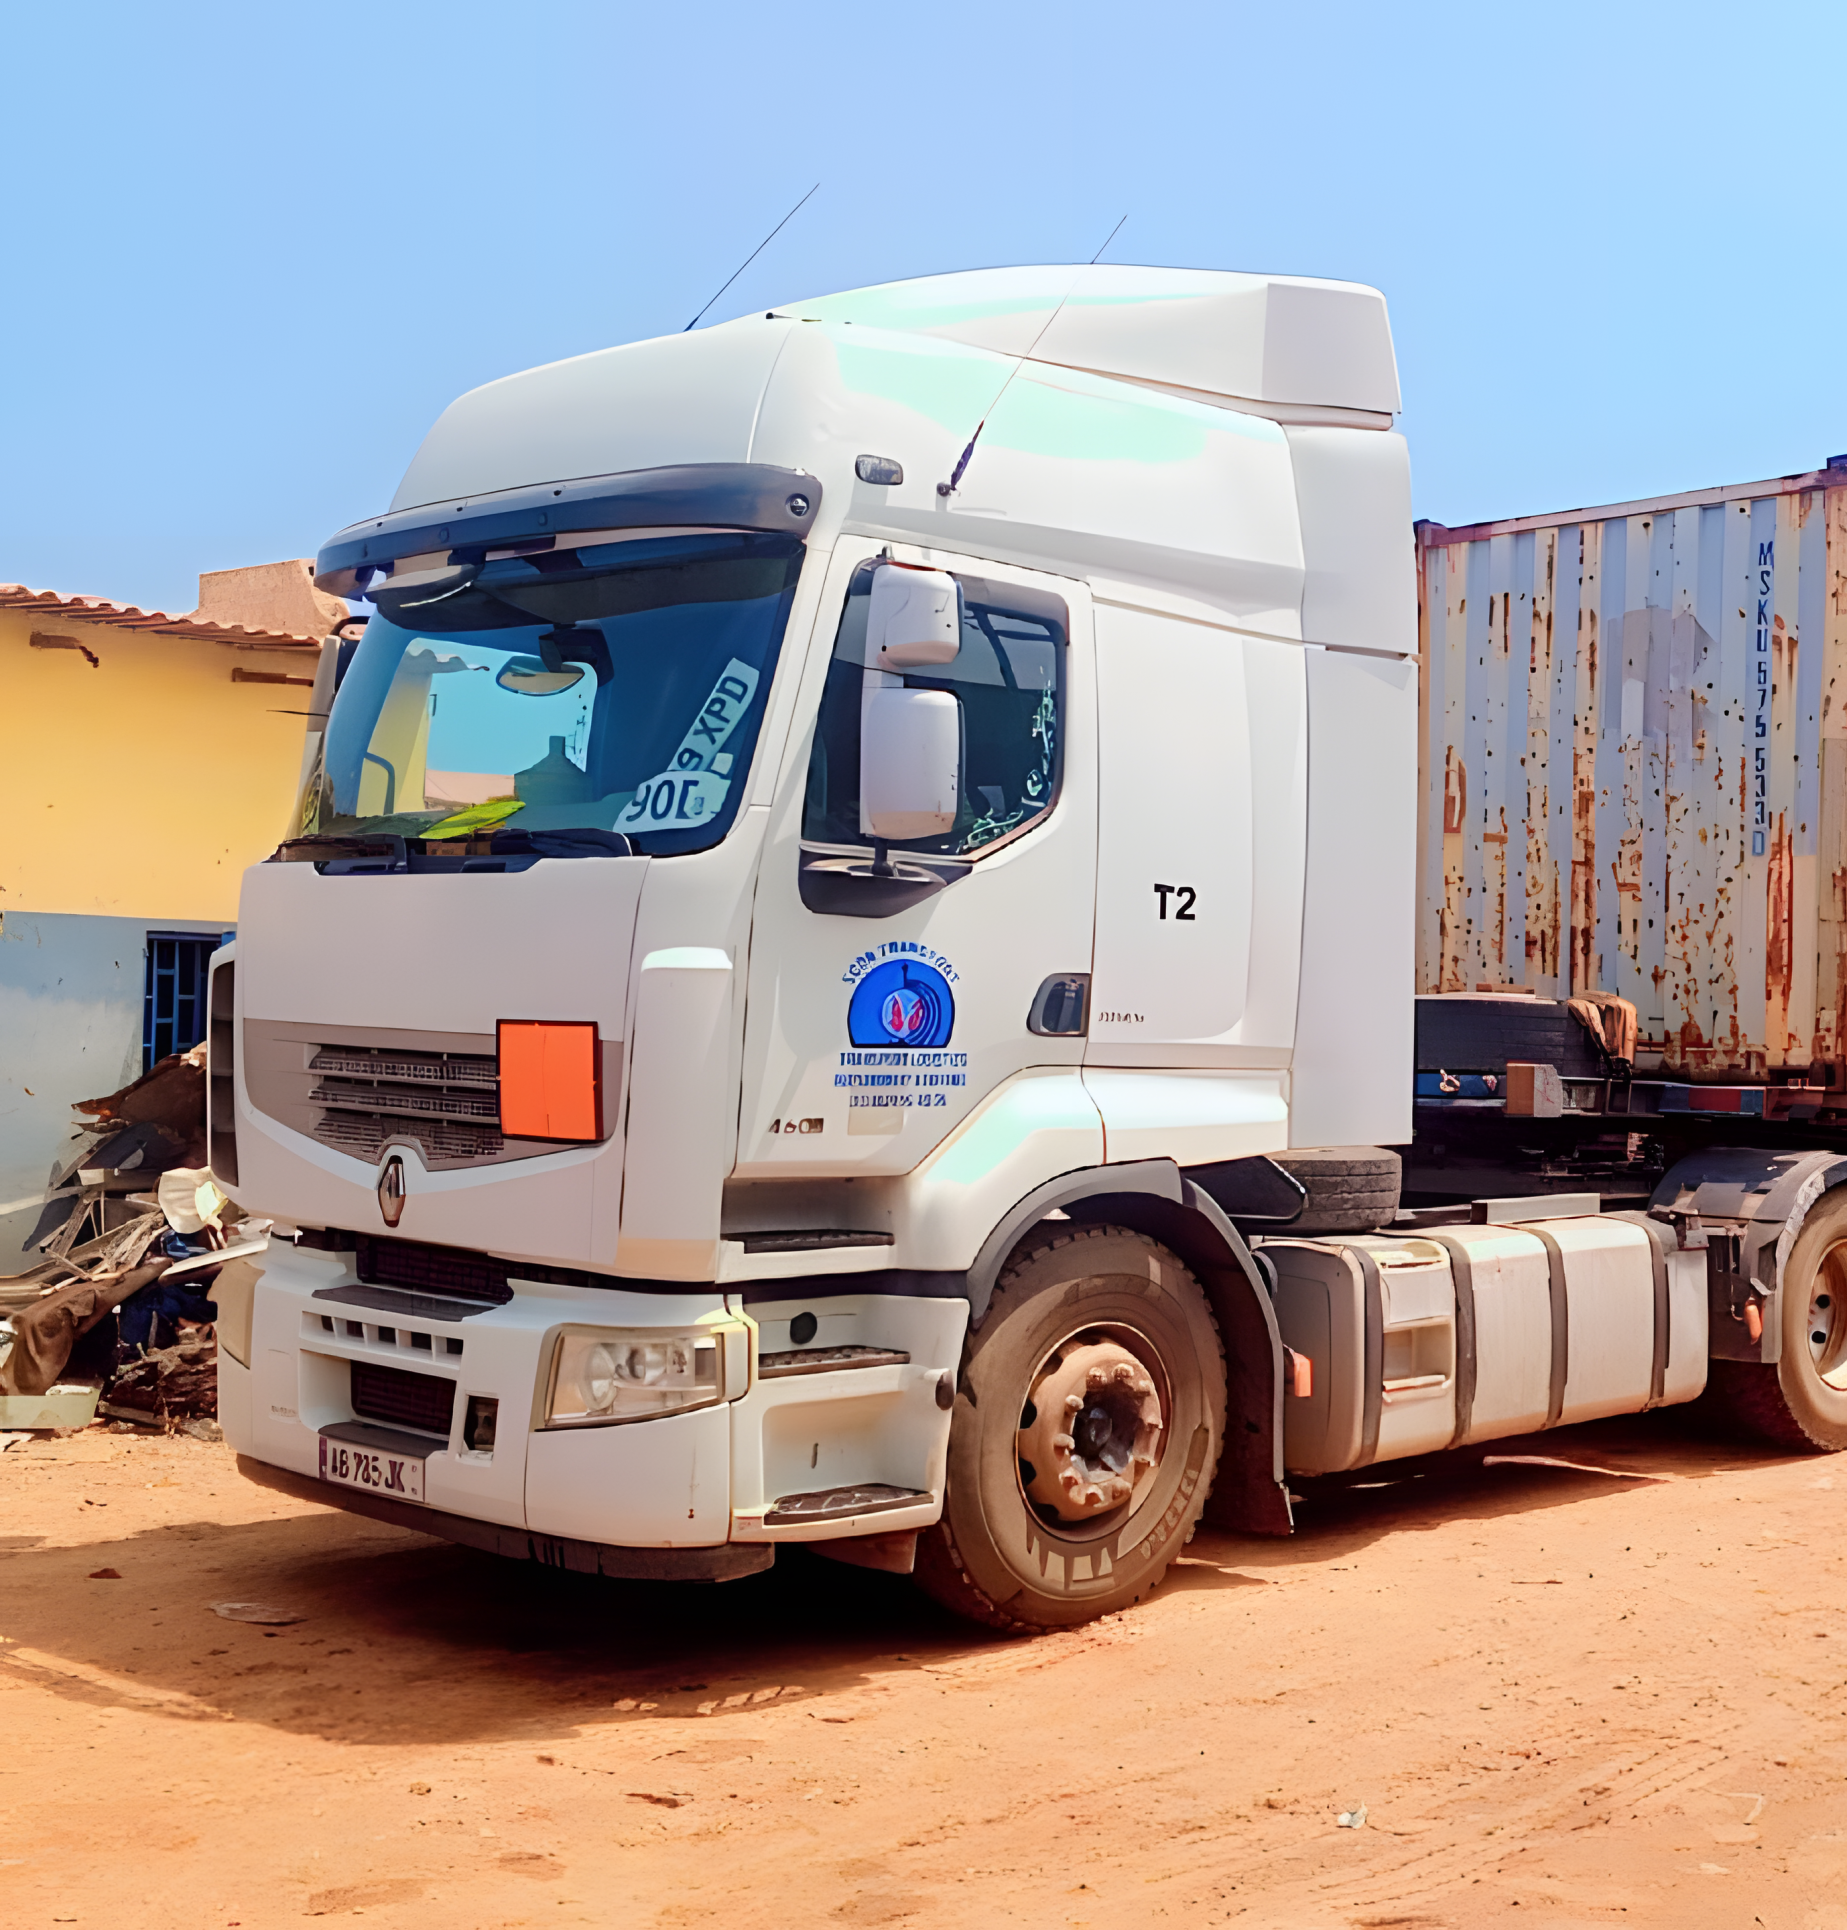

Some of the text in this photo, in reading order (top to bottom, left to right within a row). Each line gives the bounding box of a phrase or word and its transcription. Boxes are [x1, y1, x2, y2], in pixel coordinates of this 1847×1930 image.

[1756, 541, 1774, 652] MSKU
[692, 675, 749, 746] XPD
[1154, 883, 1197, 921] T2
